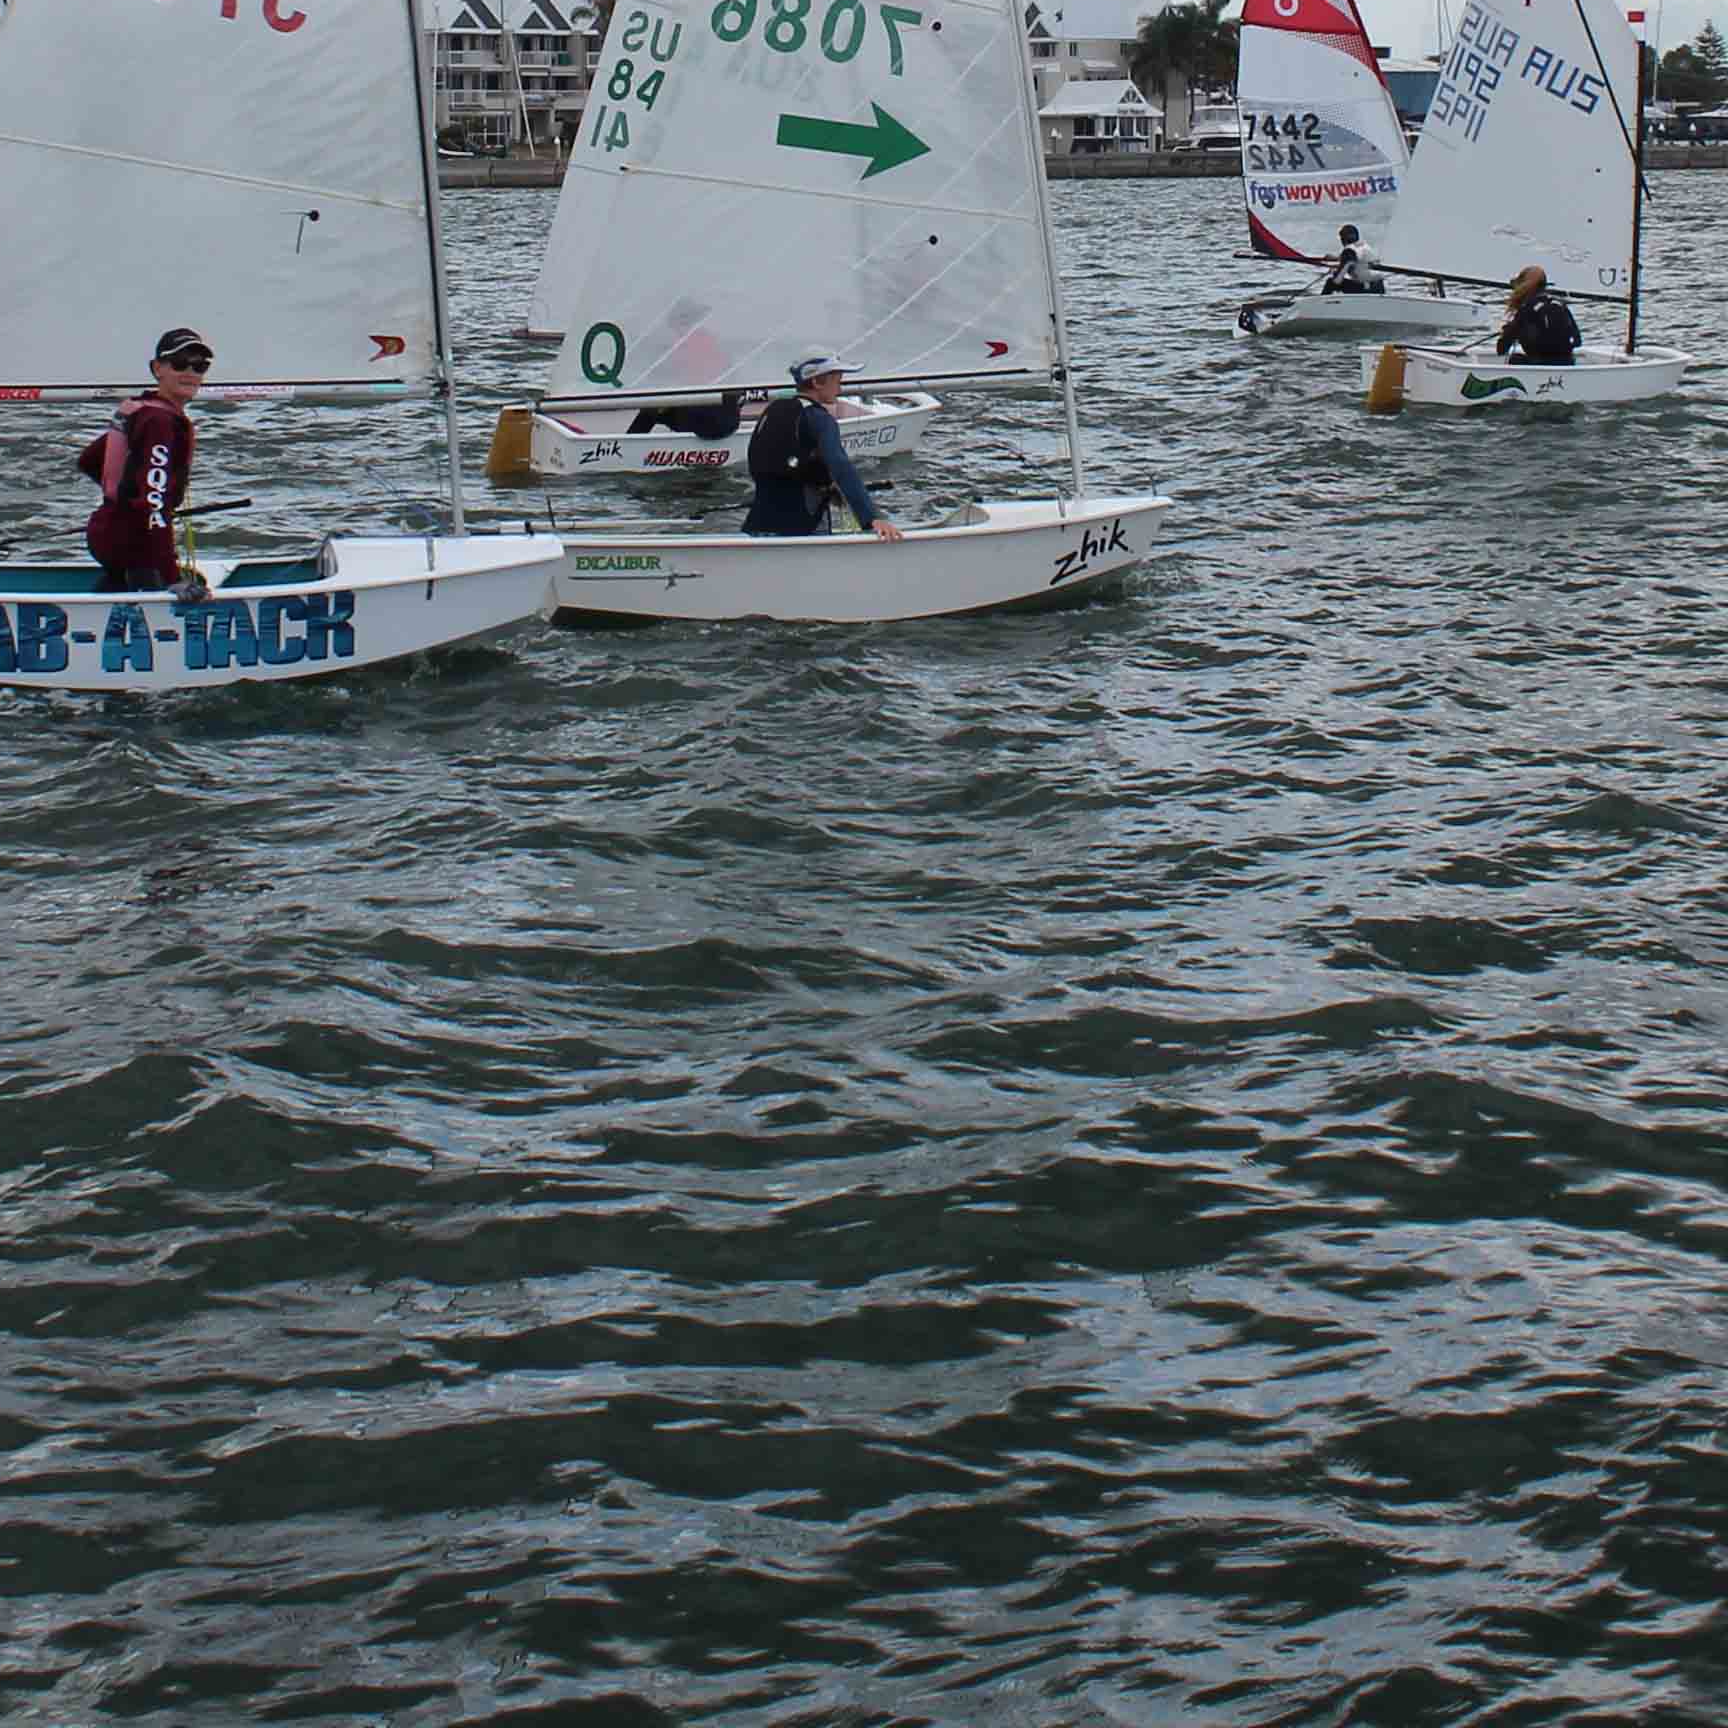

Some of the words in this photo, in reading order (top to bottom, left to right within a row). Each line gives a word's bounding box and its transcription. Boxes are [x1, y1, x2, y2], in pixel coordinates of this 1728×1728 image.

[1446, 41, 1501, 105] 1192
[1521, 45, 1605, 115] AUS
[1242, 113, 1321, 141] 7442
[1249, 181, 1321, 206] fastway
[580, 322, 625, 388] Q
[146, 444, 169, 530] SQSA
[576, 556, 661, 570] EXCALIBUR
